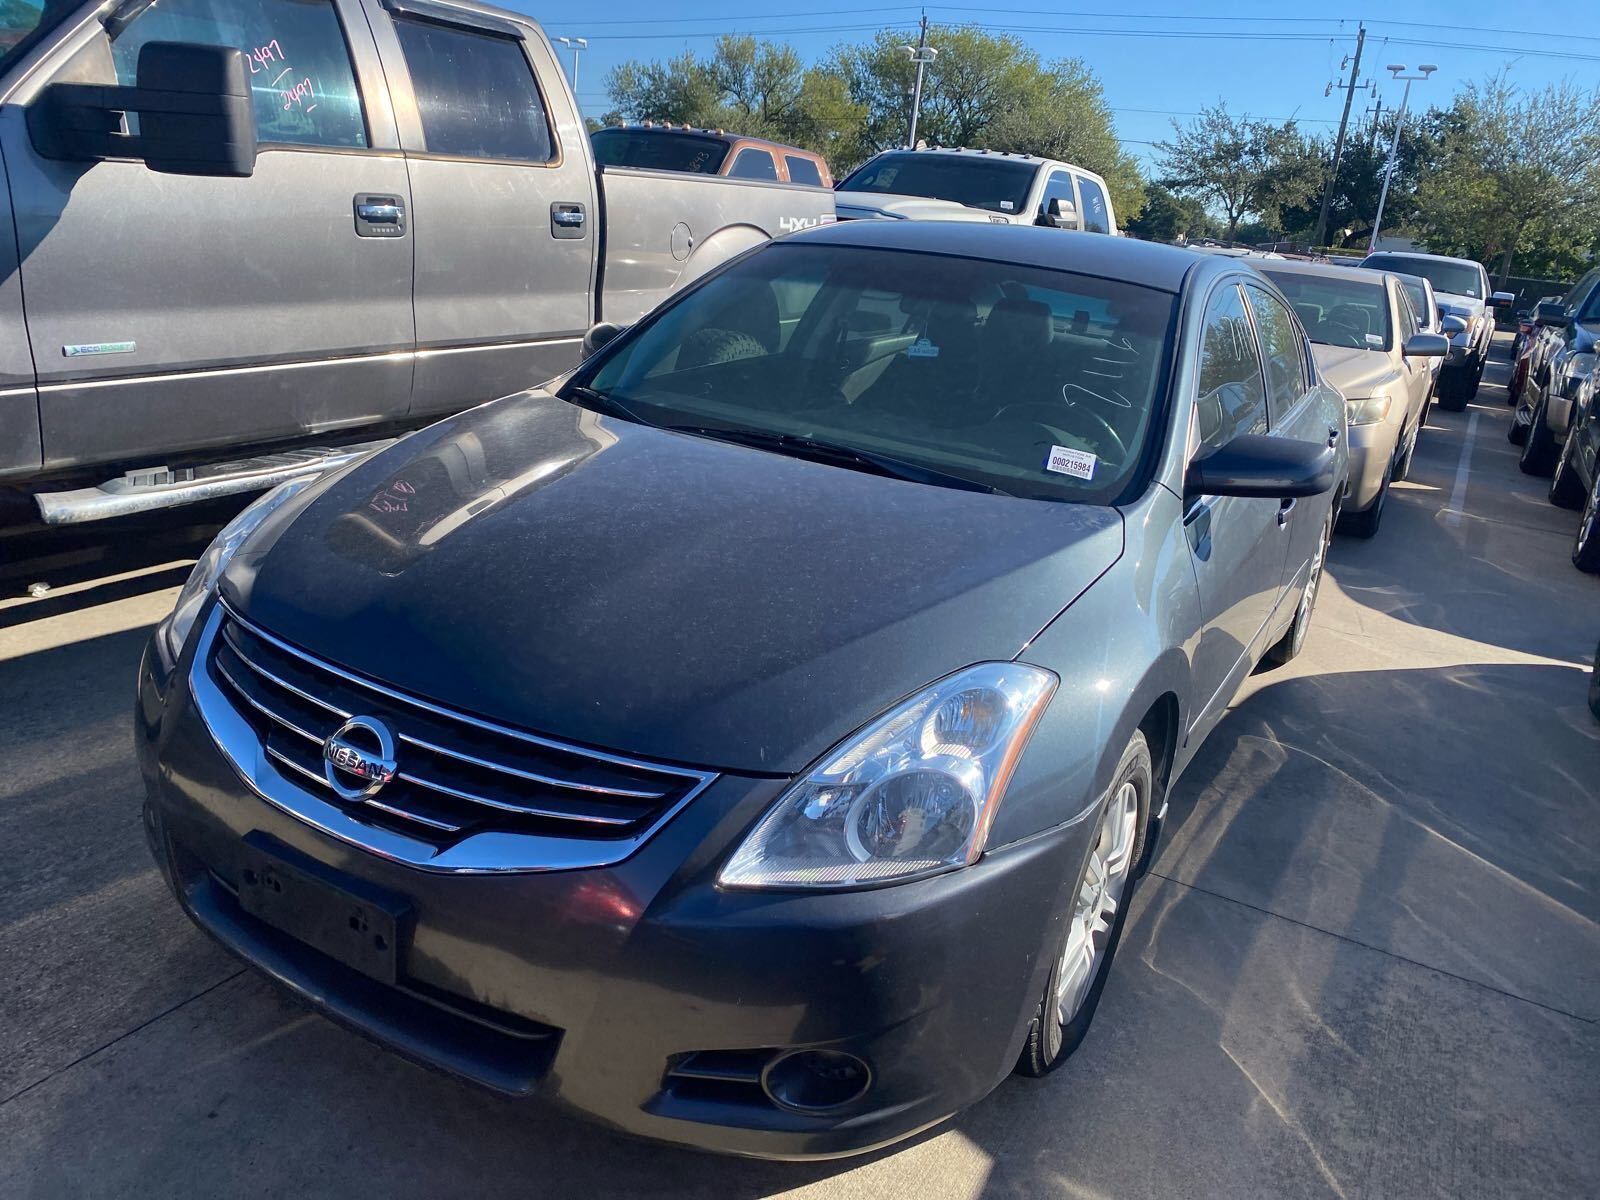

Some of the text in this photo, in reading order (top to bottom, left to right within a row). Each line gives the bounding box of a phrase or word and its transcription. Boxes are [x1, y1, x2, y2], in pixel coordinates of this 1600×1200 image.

[281, 78, 314, 110] 2497
[1052, 456, 1091, 473] 000215984
[327, 742, 386, 780] NISSAN
